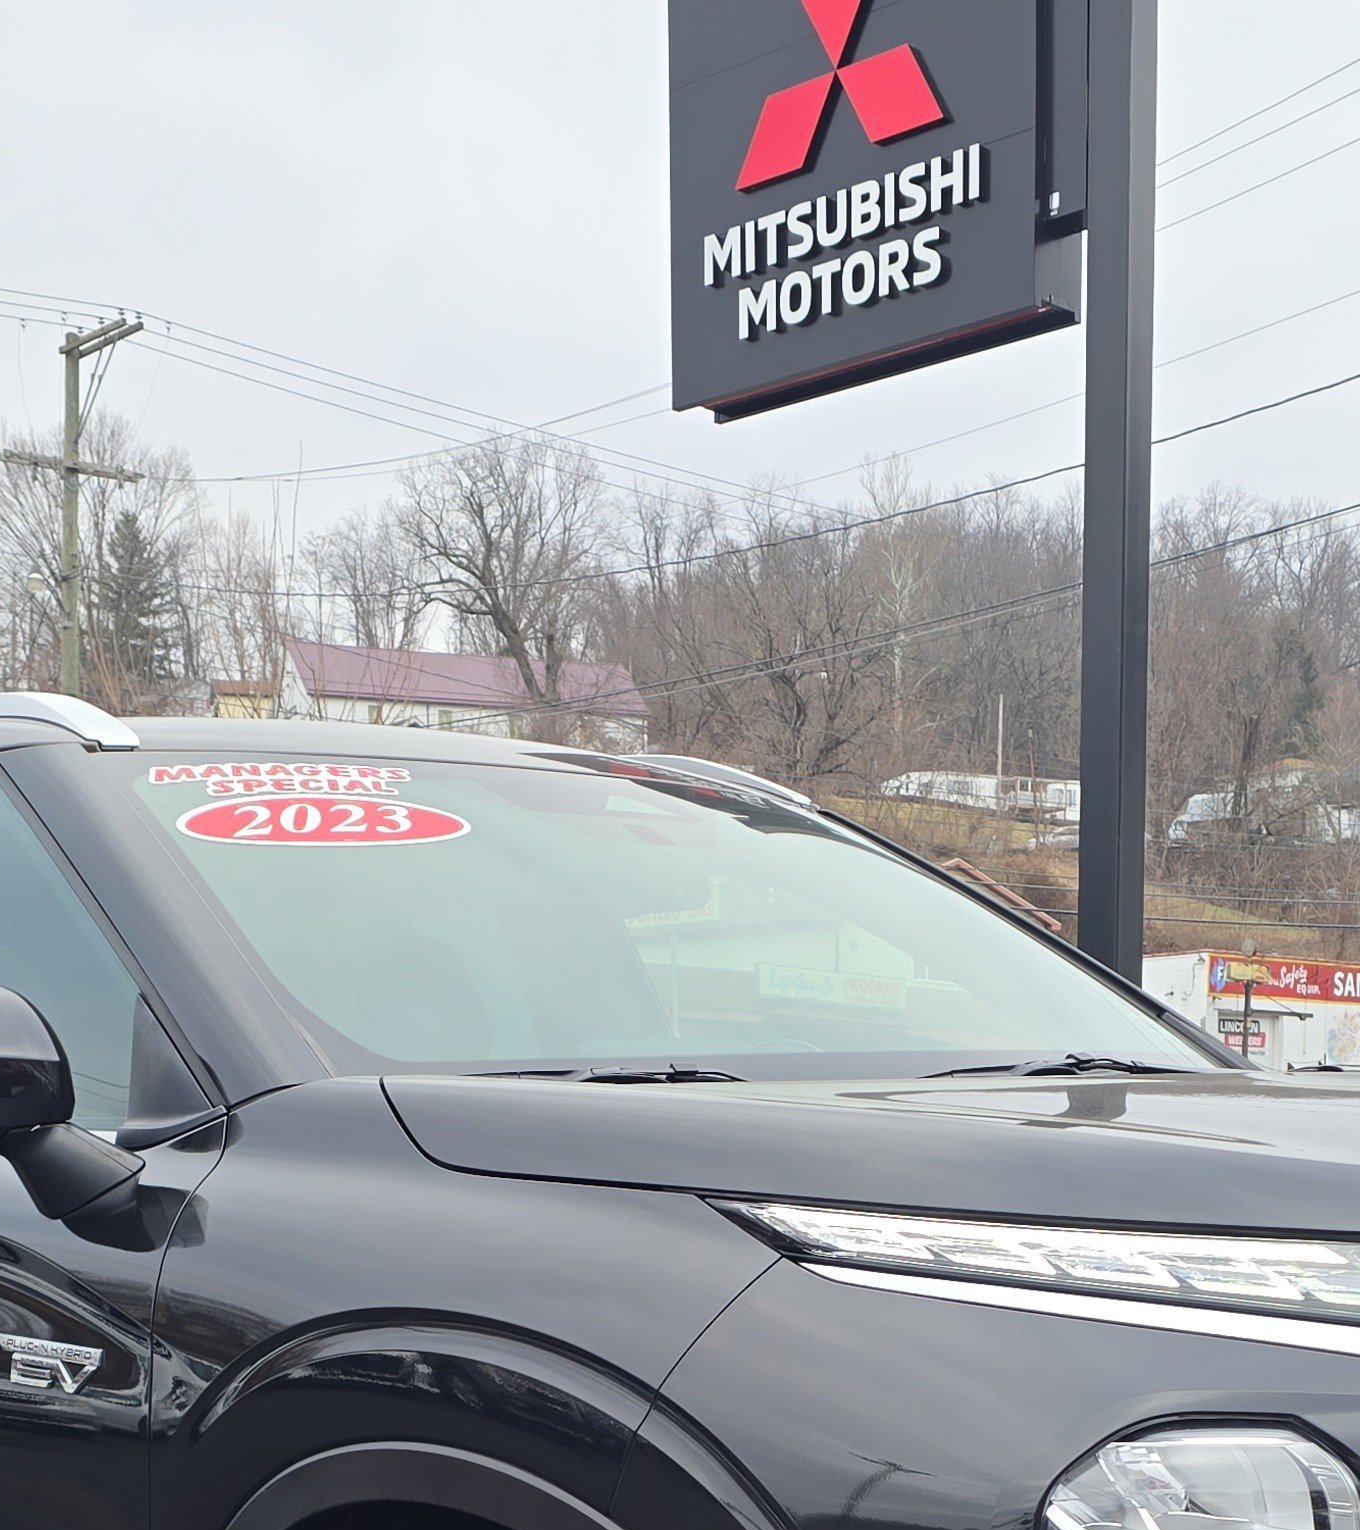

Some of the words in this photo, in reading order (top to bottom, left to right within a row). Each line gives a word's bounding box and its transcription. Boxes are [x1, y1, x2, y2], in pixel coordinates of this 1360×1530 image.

[704, 143, 981, 286] MITSUBISHI
[738, 226, 942, 340] MOTORS
[153, 764, 409, 782] MANAGERS
[209, 780, 397, 794] SPECIAL
[233, 804, 413, 837] 2023
[843, 977, 902, 997] PROPANE
[1220, 1020, 1258, 1033] LINCN
[50, 1346, 92, 1360] HYBRID
[10, 1352, 98, 1394] EV
